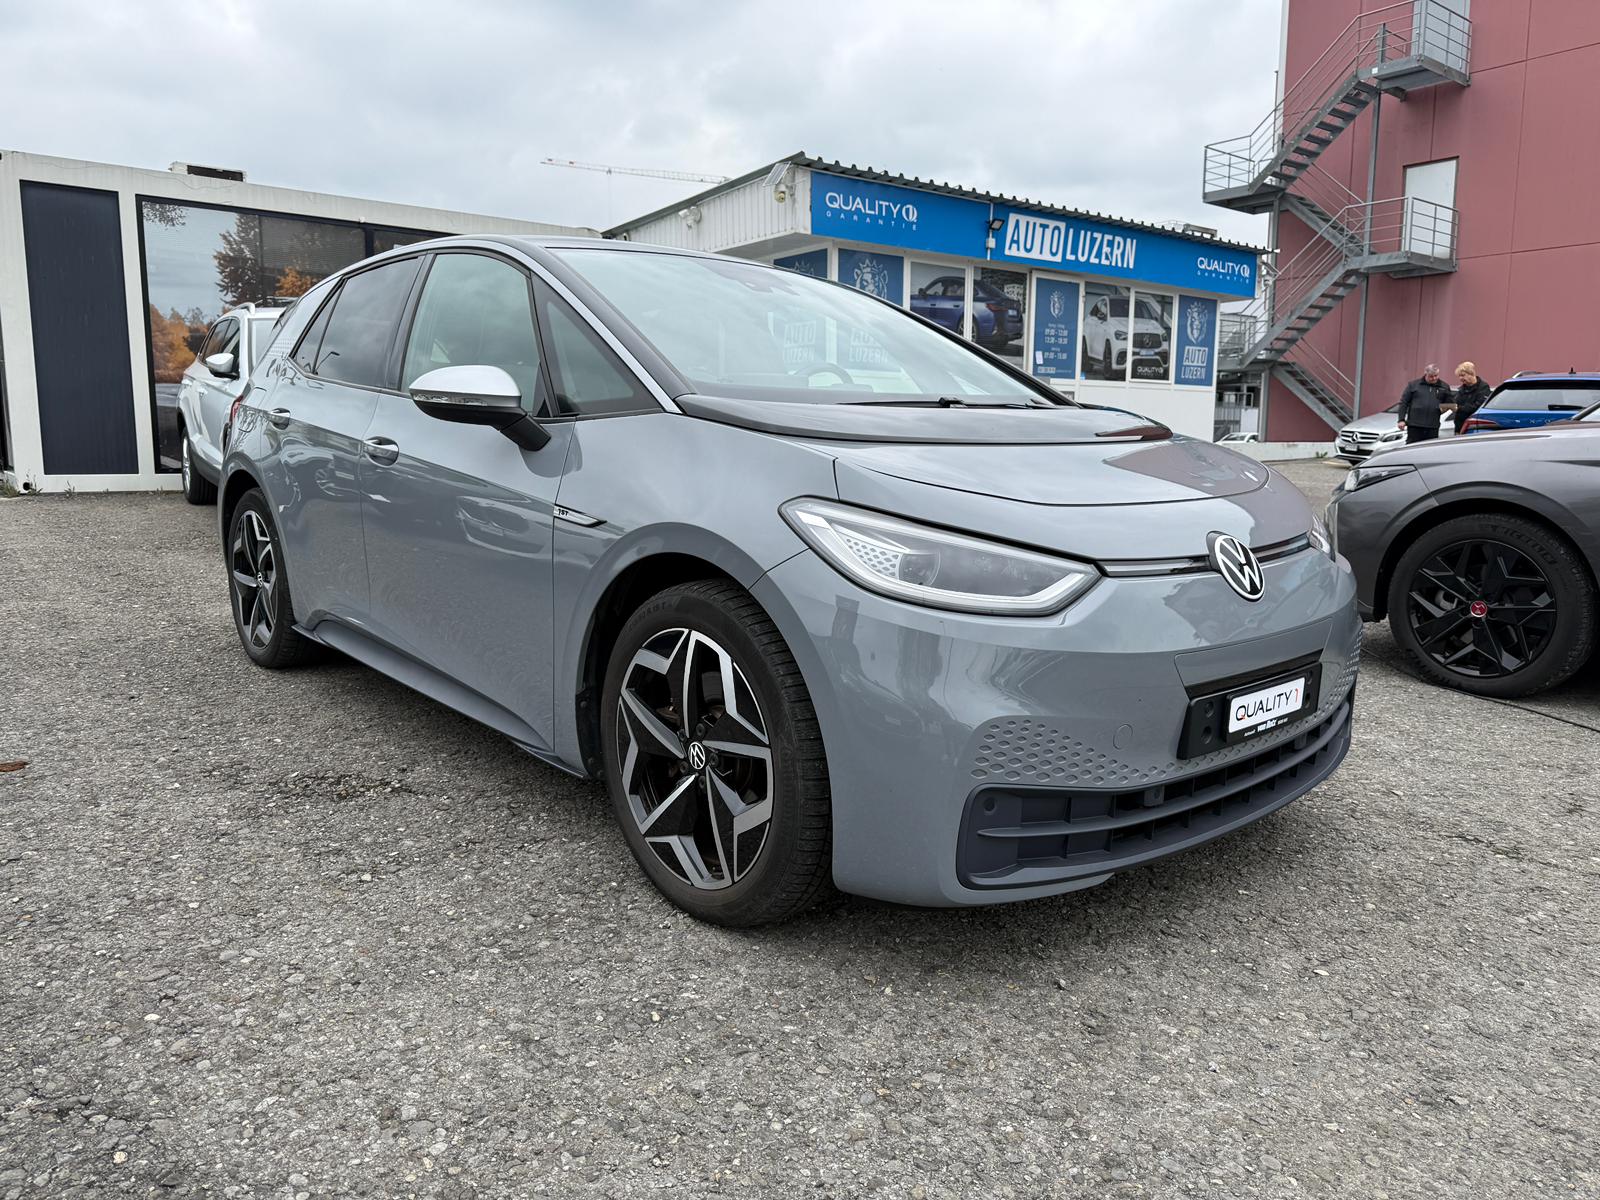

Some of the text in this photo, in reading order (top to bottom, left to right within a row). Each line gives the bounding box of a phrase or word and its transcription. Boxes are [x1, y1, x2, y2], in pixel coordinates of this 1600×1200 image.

[825, 192, 900, 219] QUALITY
[825, 210, 917, 231] GARANTIE
[1008, 218, 1137, 269] AUTO LUZERN
[1197, 256, 1241, 275] QUALITY
[784, 322, 816, 344] AUTO
[1184, 348, 1206, 364] AUTO
[1181, 366, 1206, 379] LUZERN
[557, 508, 569, 516] 1ST
[1235, 688, 1299, 721] QUALITY 1
